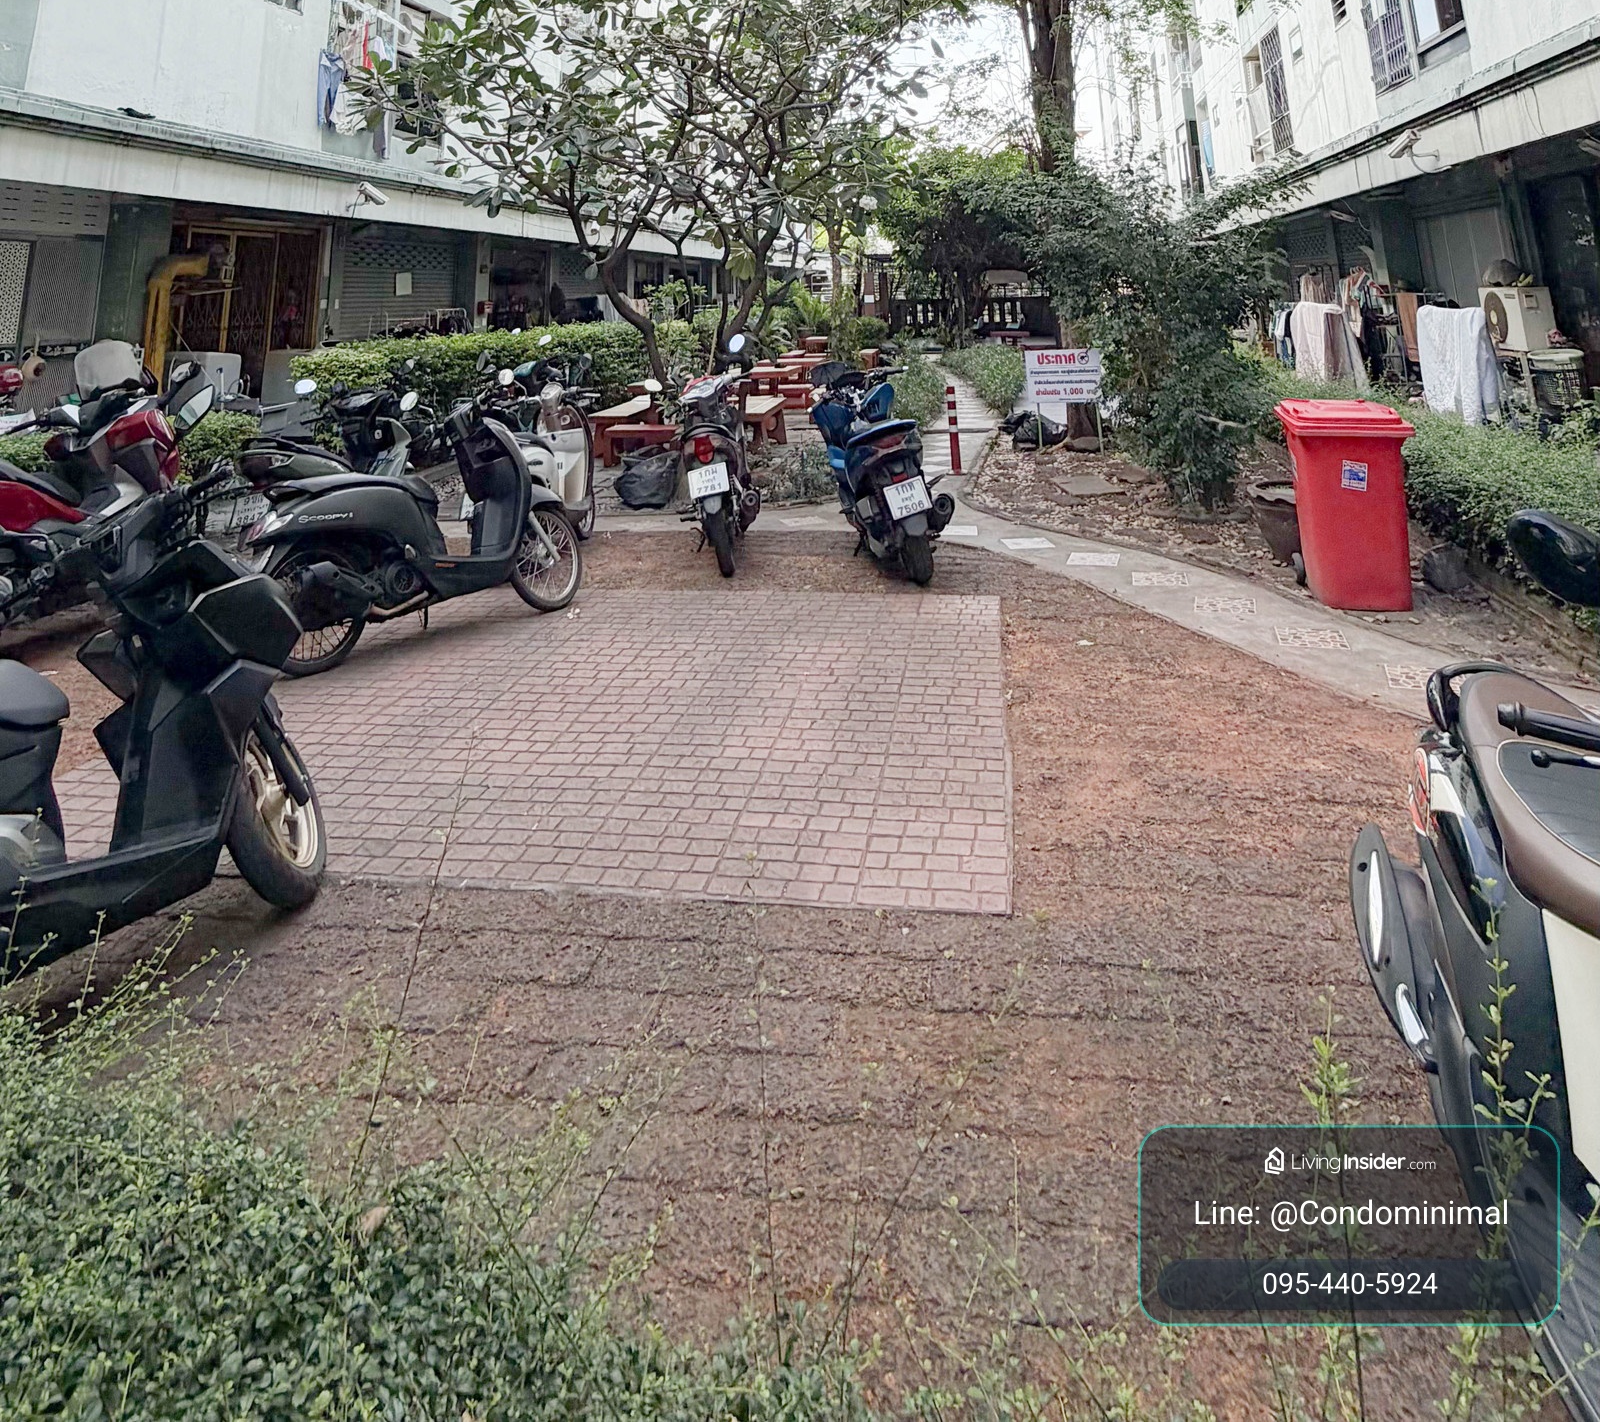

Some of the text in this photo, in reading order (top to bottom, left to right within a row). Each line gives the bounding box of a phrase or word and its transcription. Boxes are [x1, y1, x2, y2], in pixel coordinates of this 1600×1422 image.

[1037, 352, 1076, 365] ประกาศ
[1063, 387, 1084, 395] 1,000
[696, 482, 722, 494] 7781
[897, 500, 925, 516] 7506
